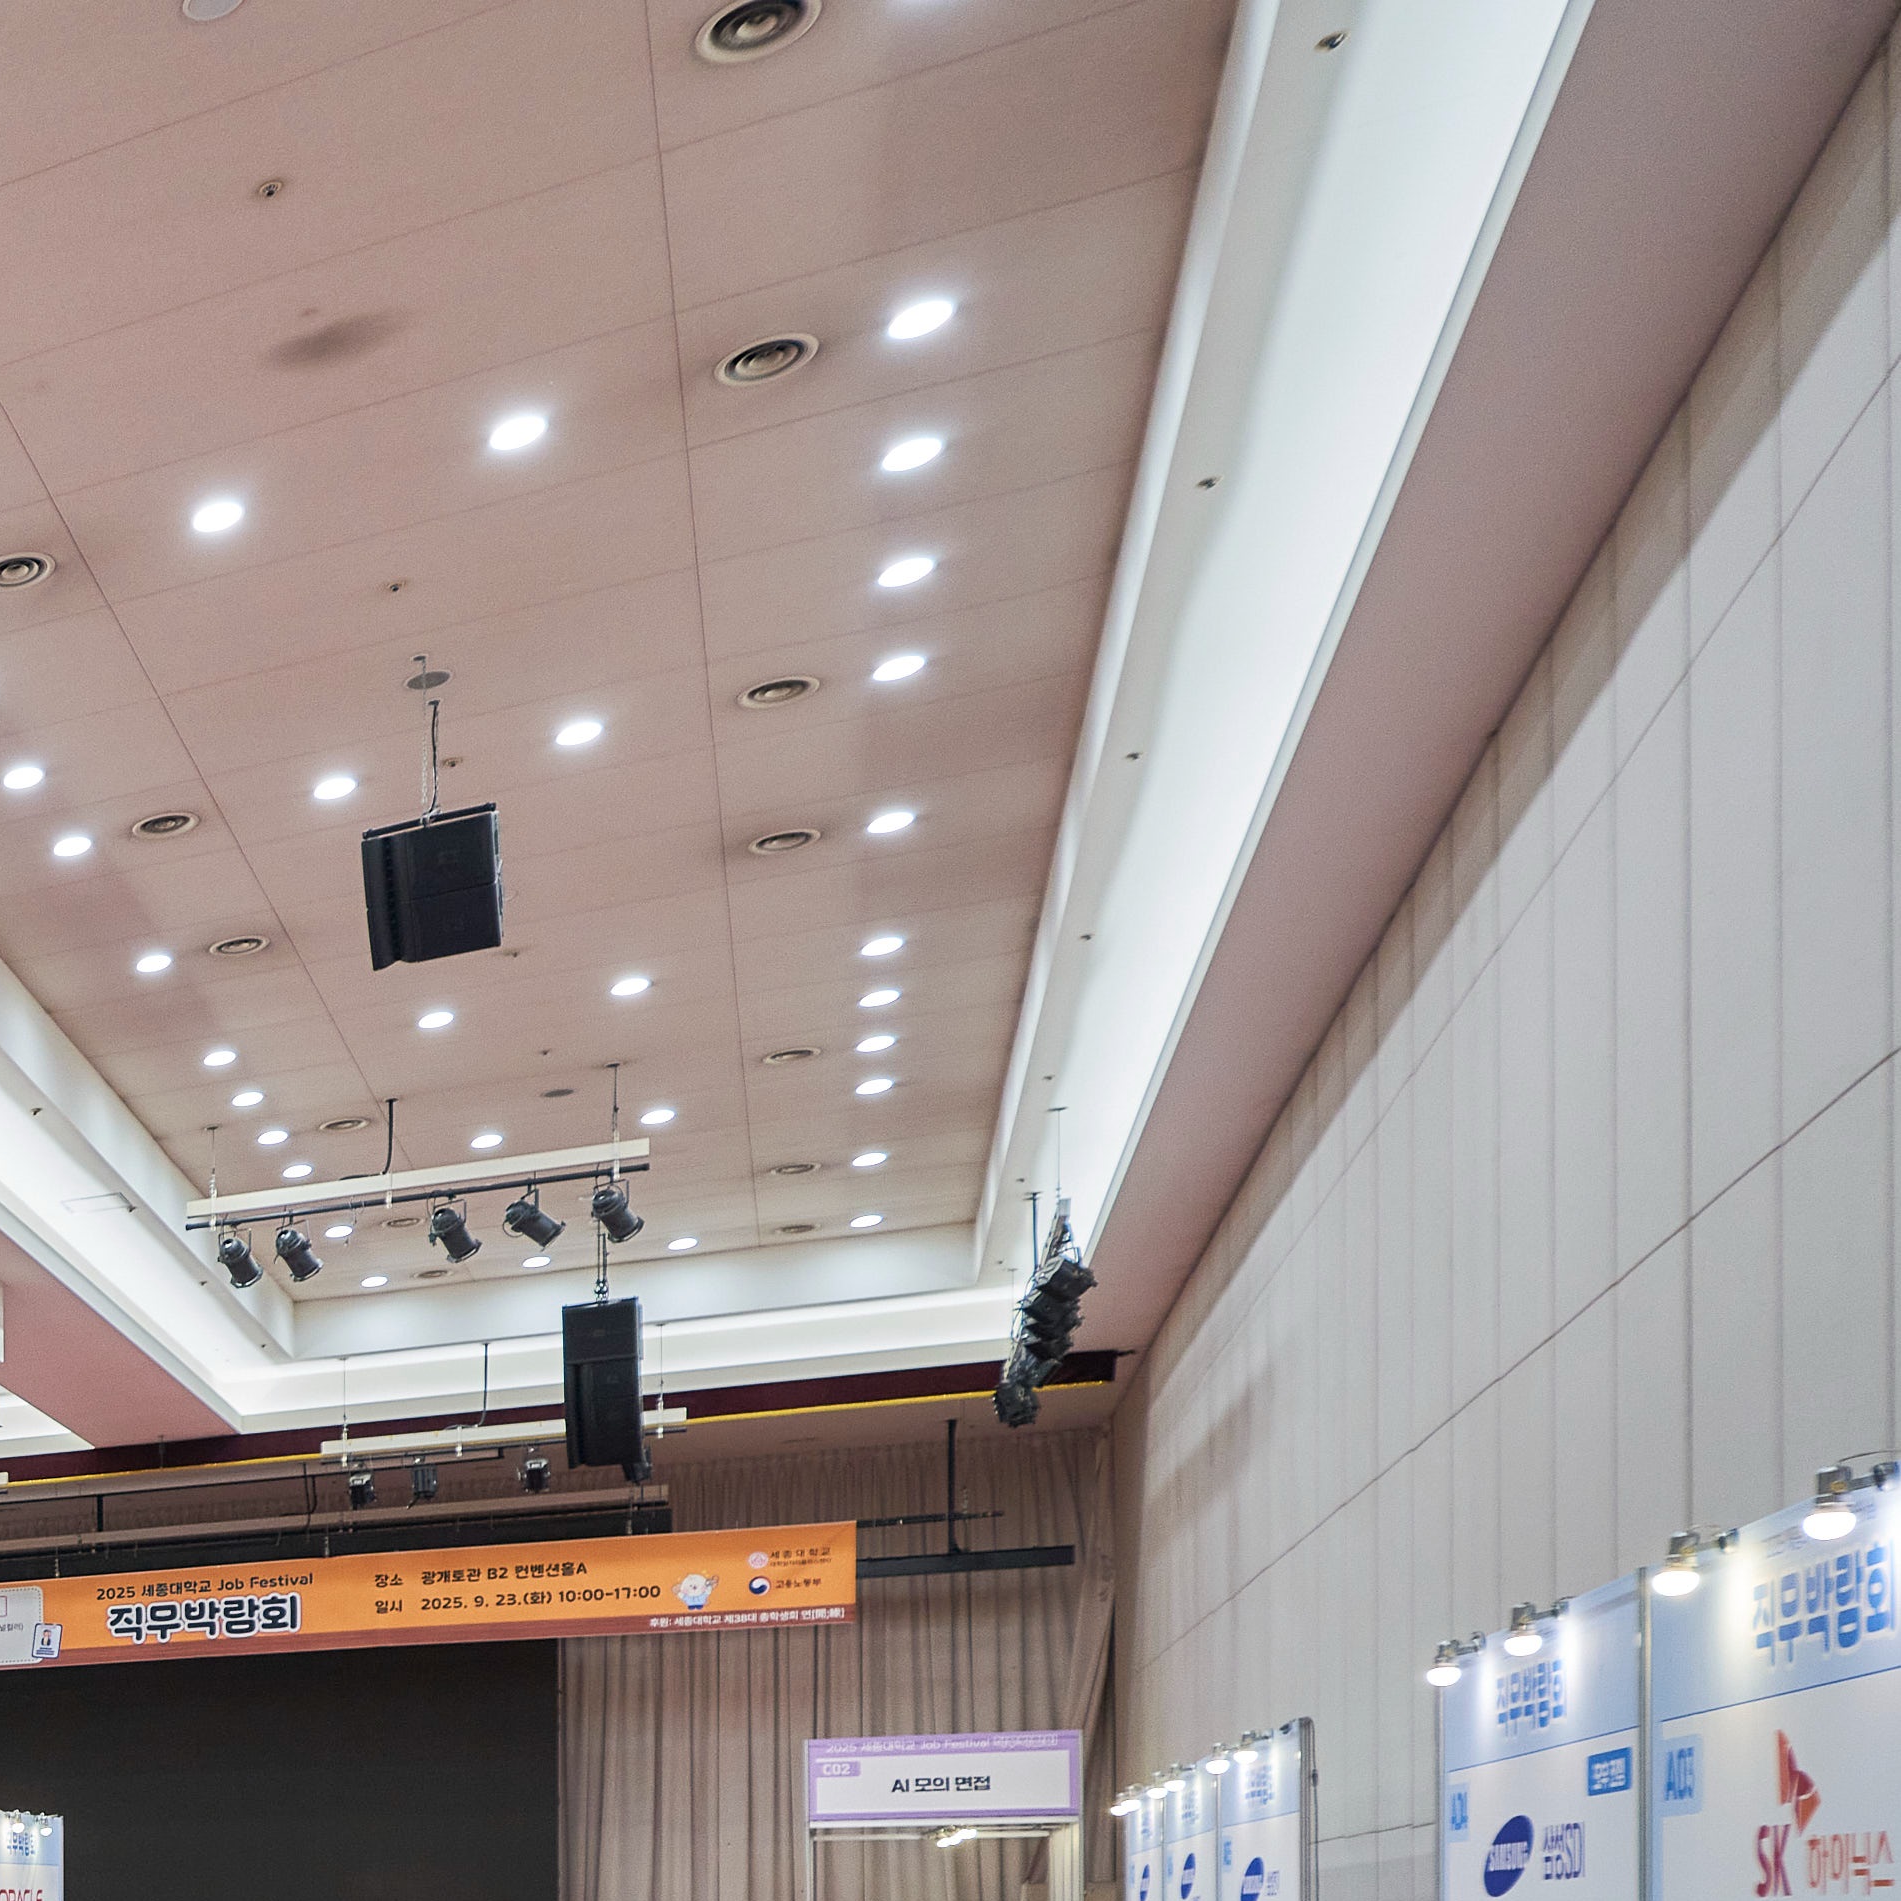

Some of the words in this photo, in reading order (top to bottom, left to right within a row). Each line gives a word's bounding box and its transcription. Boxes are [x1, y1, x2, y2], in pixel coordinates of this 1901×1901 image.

[97, 1586, 136, 1600] 2025
[141, 1580, 212, 1597] 세종대학교
[217, 1578, 244, 1592] Job
[250, 1572, 313, 1589] Festival
[375, 1573, 403, 1588] 장소
[421, 1570, 481, 1586] 광개토관
[487, 1567, 509, 1580] B2
[375, 1599, 403, 1614] 일시
[421, 1597, 468, 1611] 2025.
[474, 1595, 489, 1608] 9.
[558, 1585, 661, 1603] 10:00-17:00
[1753, 1542, 1895, 1666] 직무박람회
[108, 1594, 299, 1642] 직무박람회
[822, 1764, 851, 1776] C02
[891, 1779, 910, 1793] AI
[915, 1777, 950, 1792] 모의
[954, 1775, 991, 1791] 면접
[1756, 1823, 1792, 1898] SK
[1808, 1830, 1895, 1896] 하이닉스
